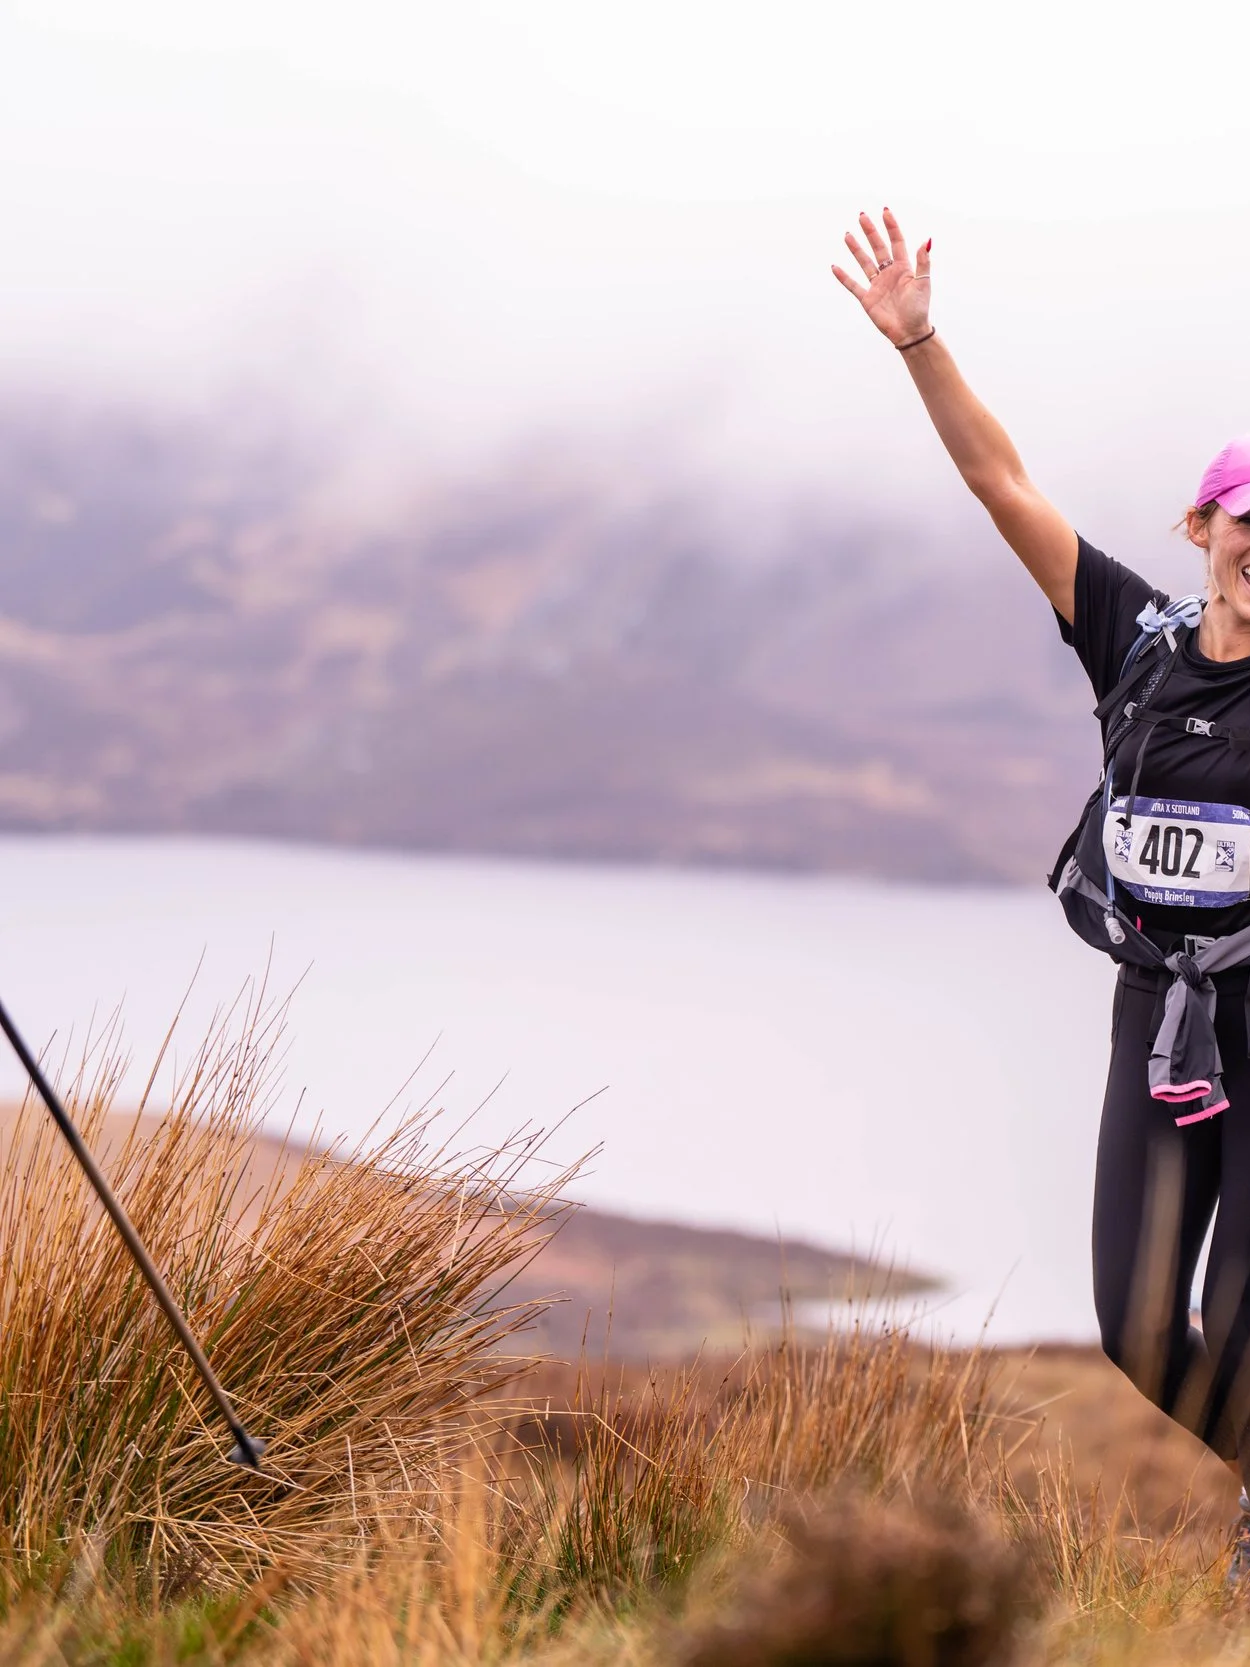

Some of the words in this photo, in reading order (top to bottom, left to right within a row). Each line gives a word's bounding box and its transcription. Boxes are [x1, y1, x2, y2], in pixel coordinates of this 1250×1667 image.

[1165, 803, 1171, 813] X
[1171, 804, 1200, 816] SCOTLAND
[1139, 825, 1204, 879] 402
[1144, 887, 1163, 903] Poppy
[1164, 890, 1195, 905] Brinsley
